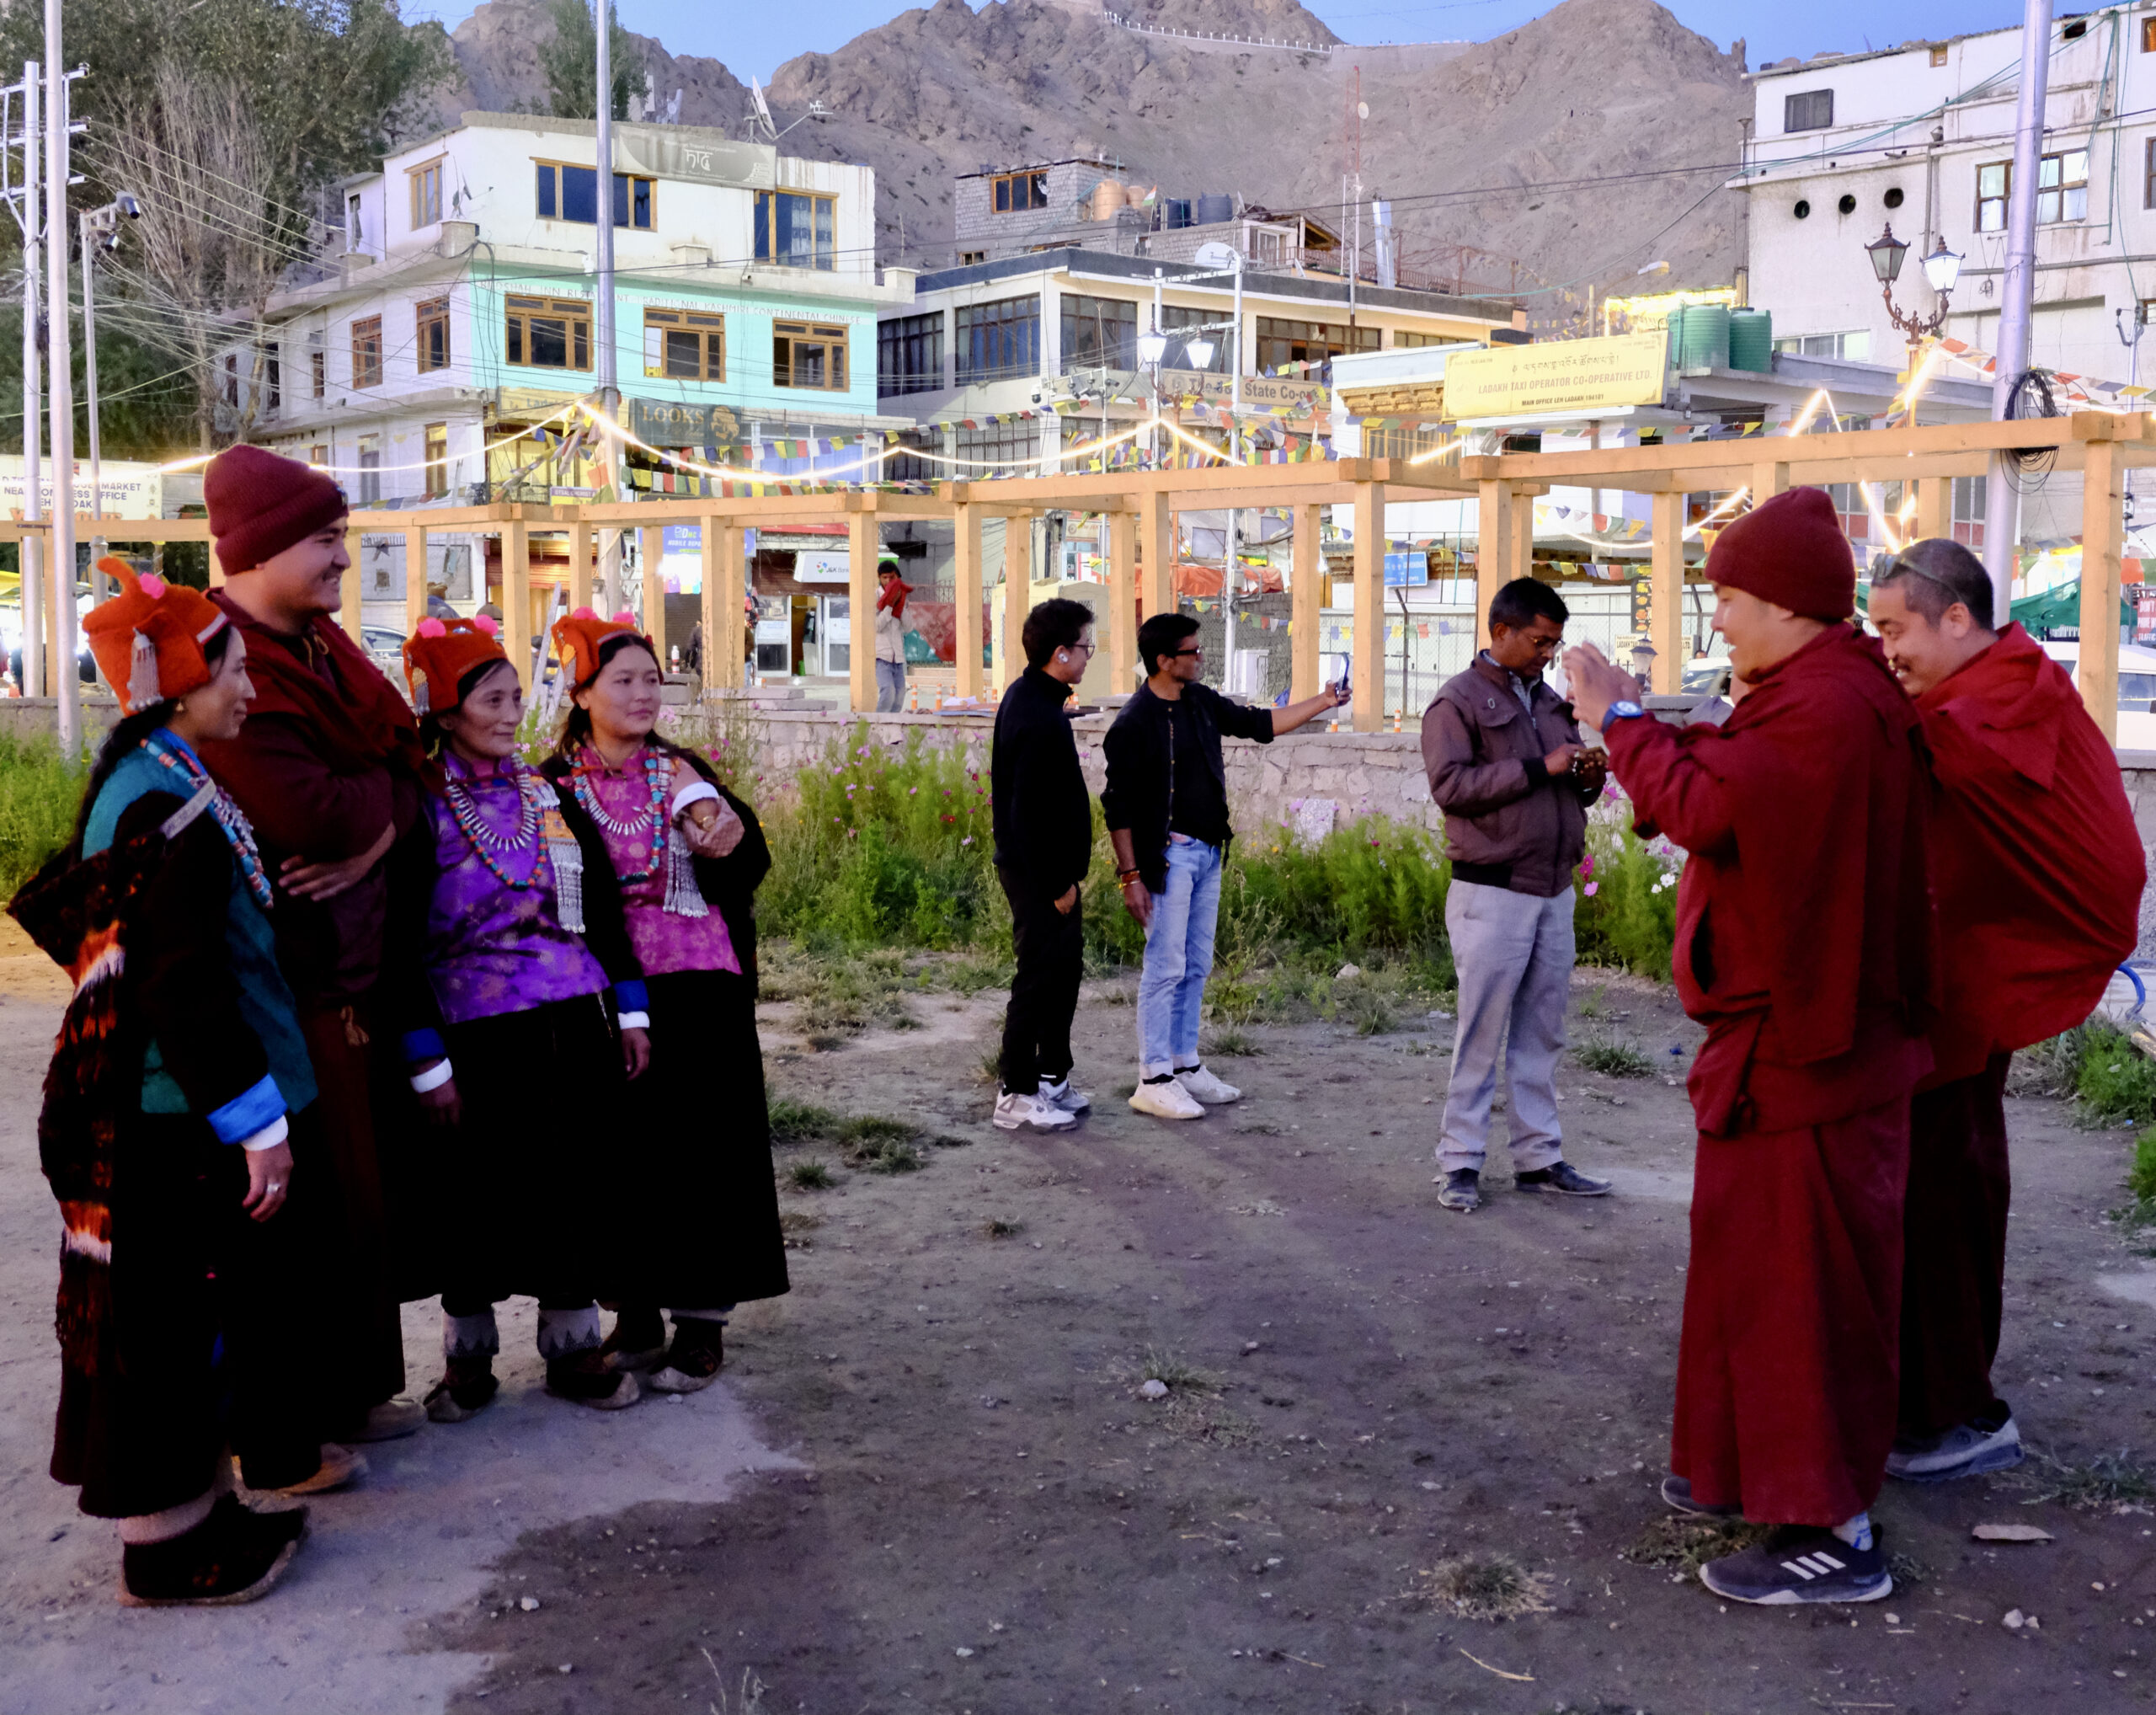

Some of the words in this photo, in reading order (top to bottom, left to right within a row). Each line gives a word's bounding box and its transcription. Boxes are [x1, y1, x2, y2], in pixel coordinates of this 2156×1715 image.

[1478, 382, 1508, 394] LADAKH
[1511, 381, 1527, 391] TAXI
[1529, 377, 1571, 390] OPERATOR
[1573, 371, 1633, 386] CO-OPERATIVE
[1636, 370, 1652, 380] LTD.
[1245, 382, 1276, 398] State
[643, 406, 705, 425] LOOKS
[4, 486, 24, 495] NEA
[100, 491, 127, 500] FFICE
[101, 482, 141, 492] MARKET
[41, 498, 51, 506] EH
[74, 500, 93, 509] DAK
